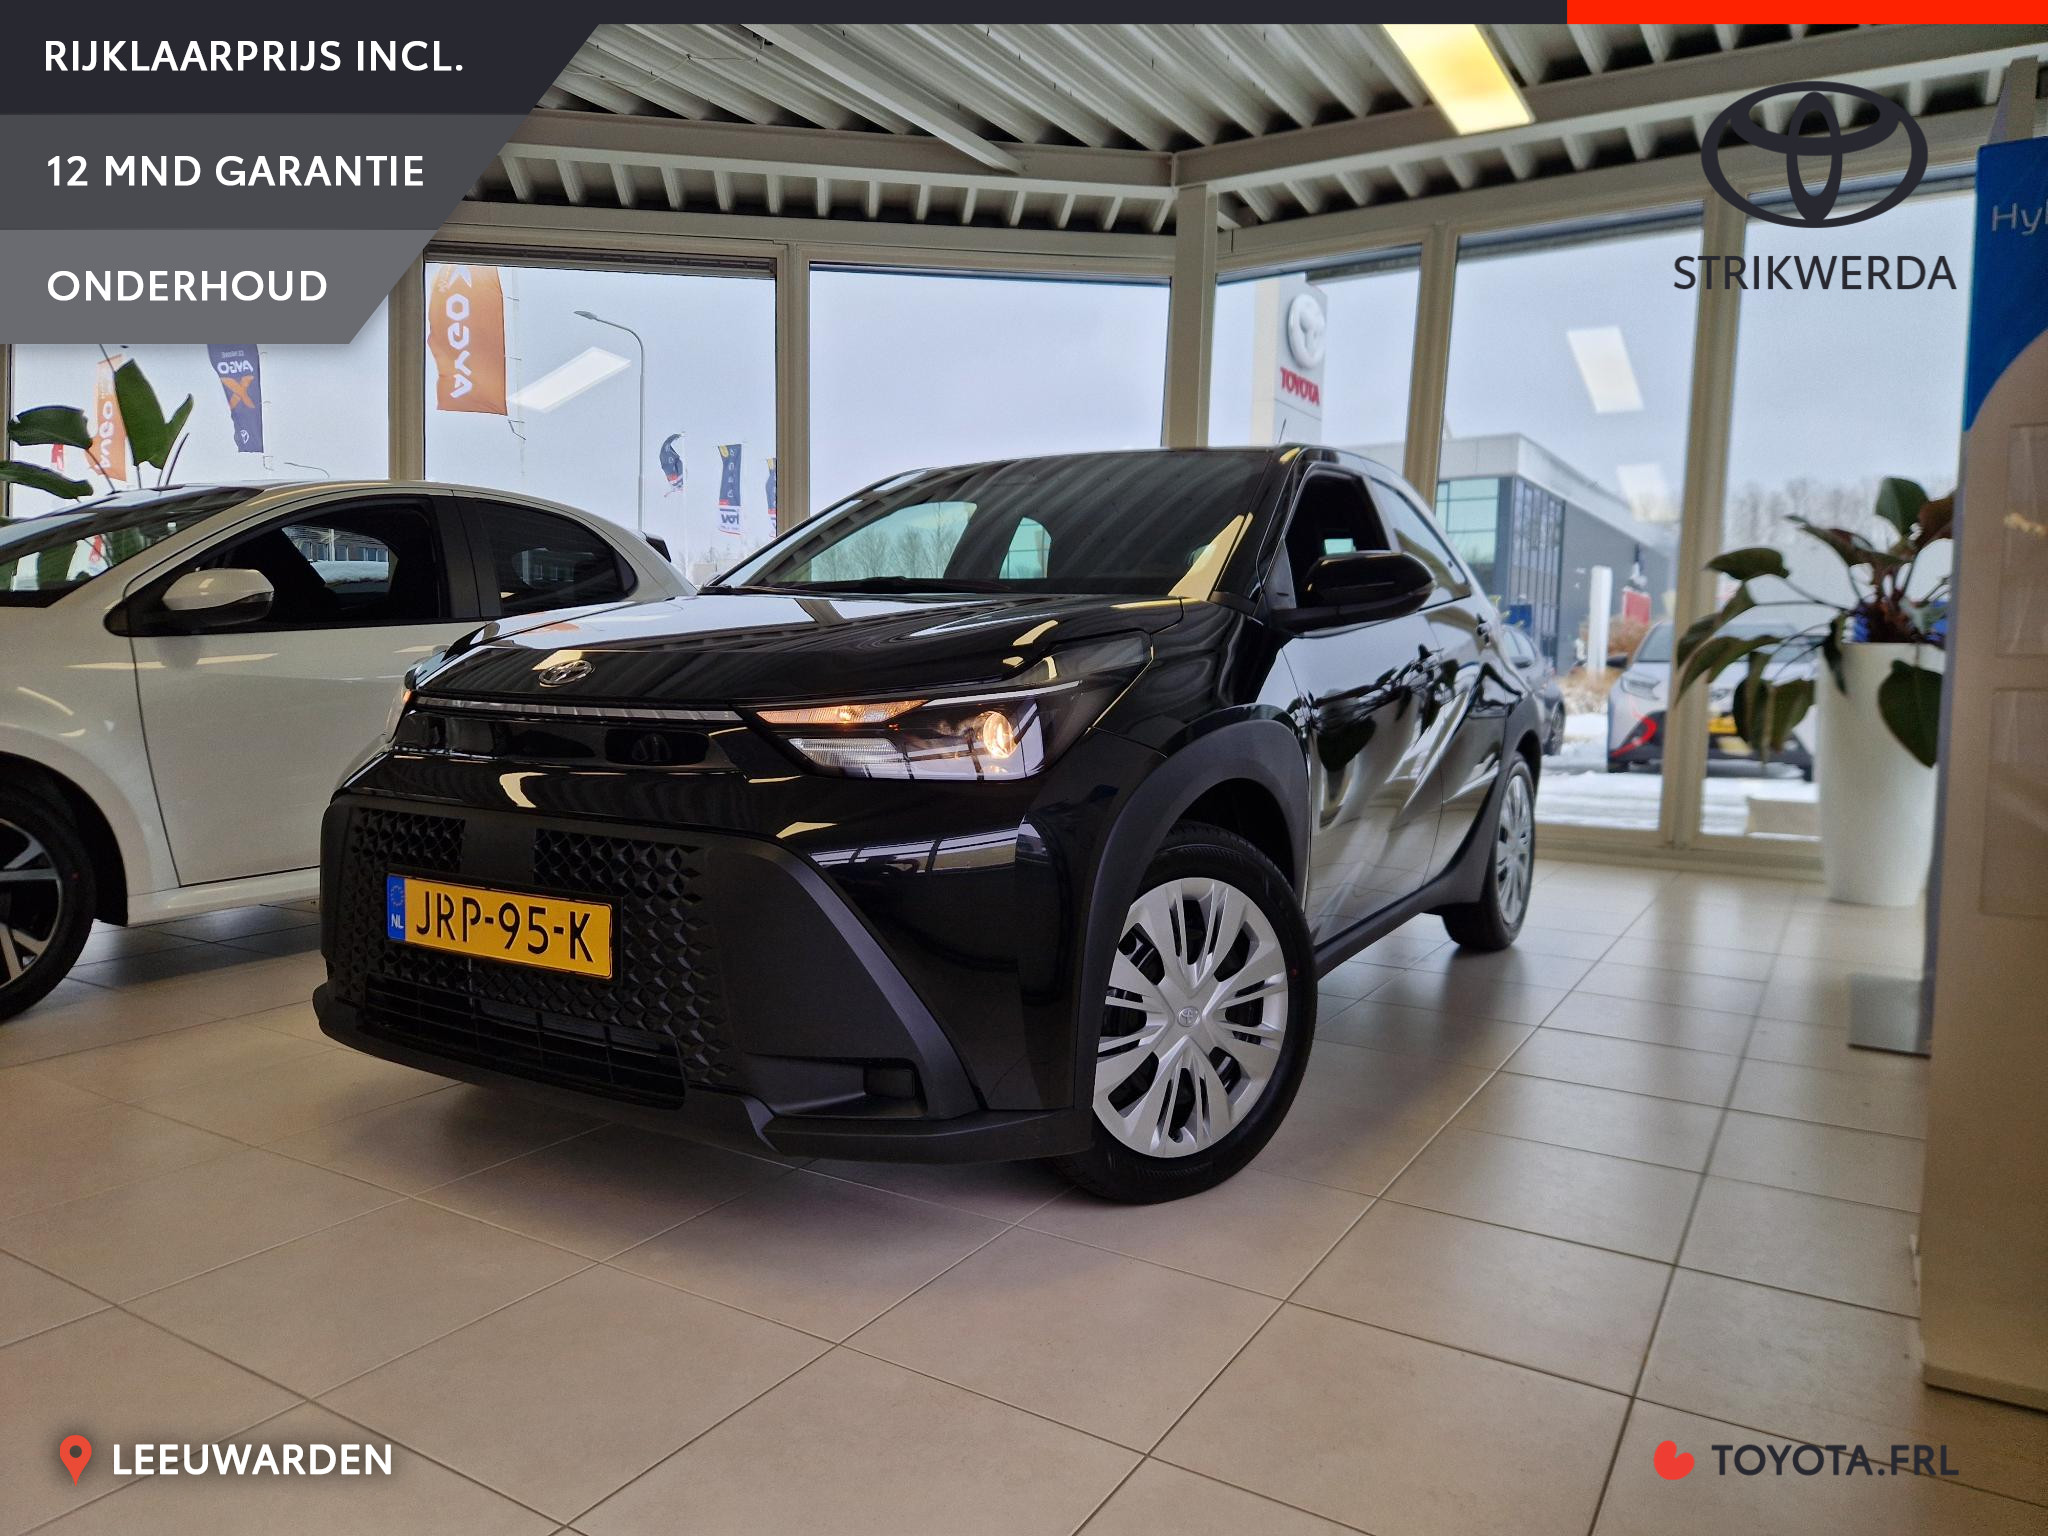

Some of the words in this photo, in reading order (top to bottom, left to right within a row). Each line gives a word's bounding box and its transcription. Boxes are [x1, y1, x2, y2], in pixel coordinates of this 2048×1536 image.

[1991, 199, 2048, 236] Hy
[1279, 366, 1320, 407] TOYOTA
[391, 915, 404, 930] NL
[416, 891, 594, 963] JRP-95-K
